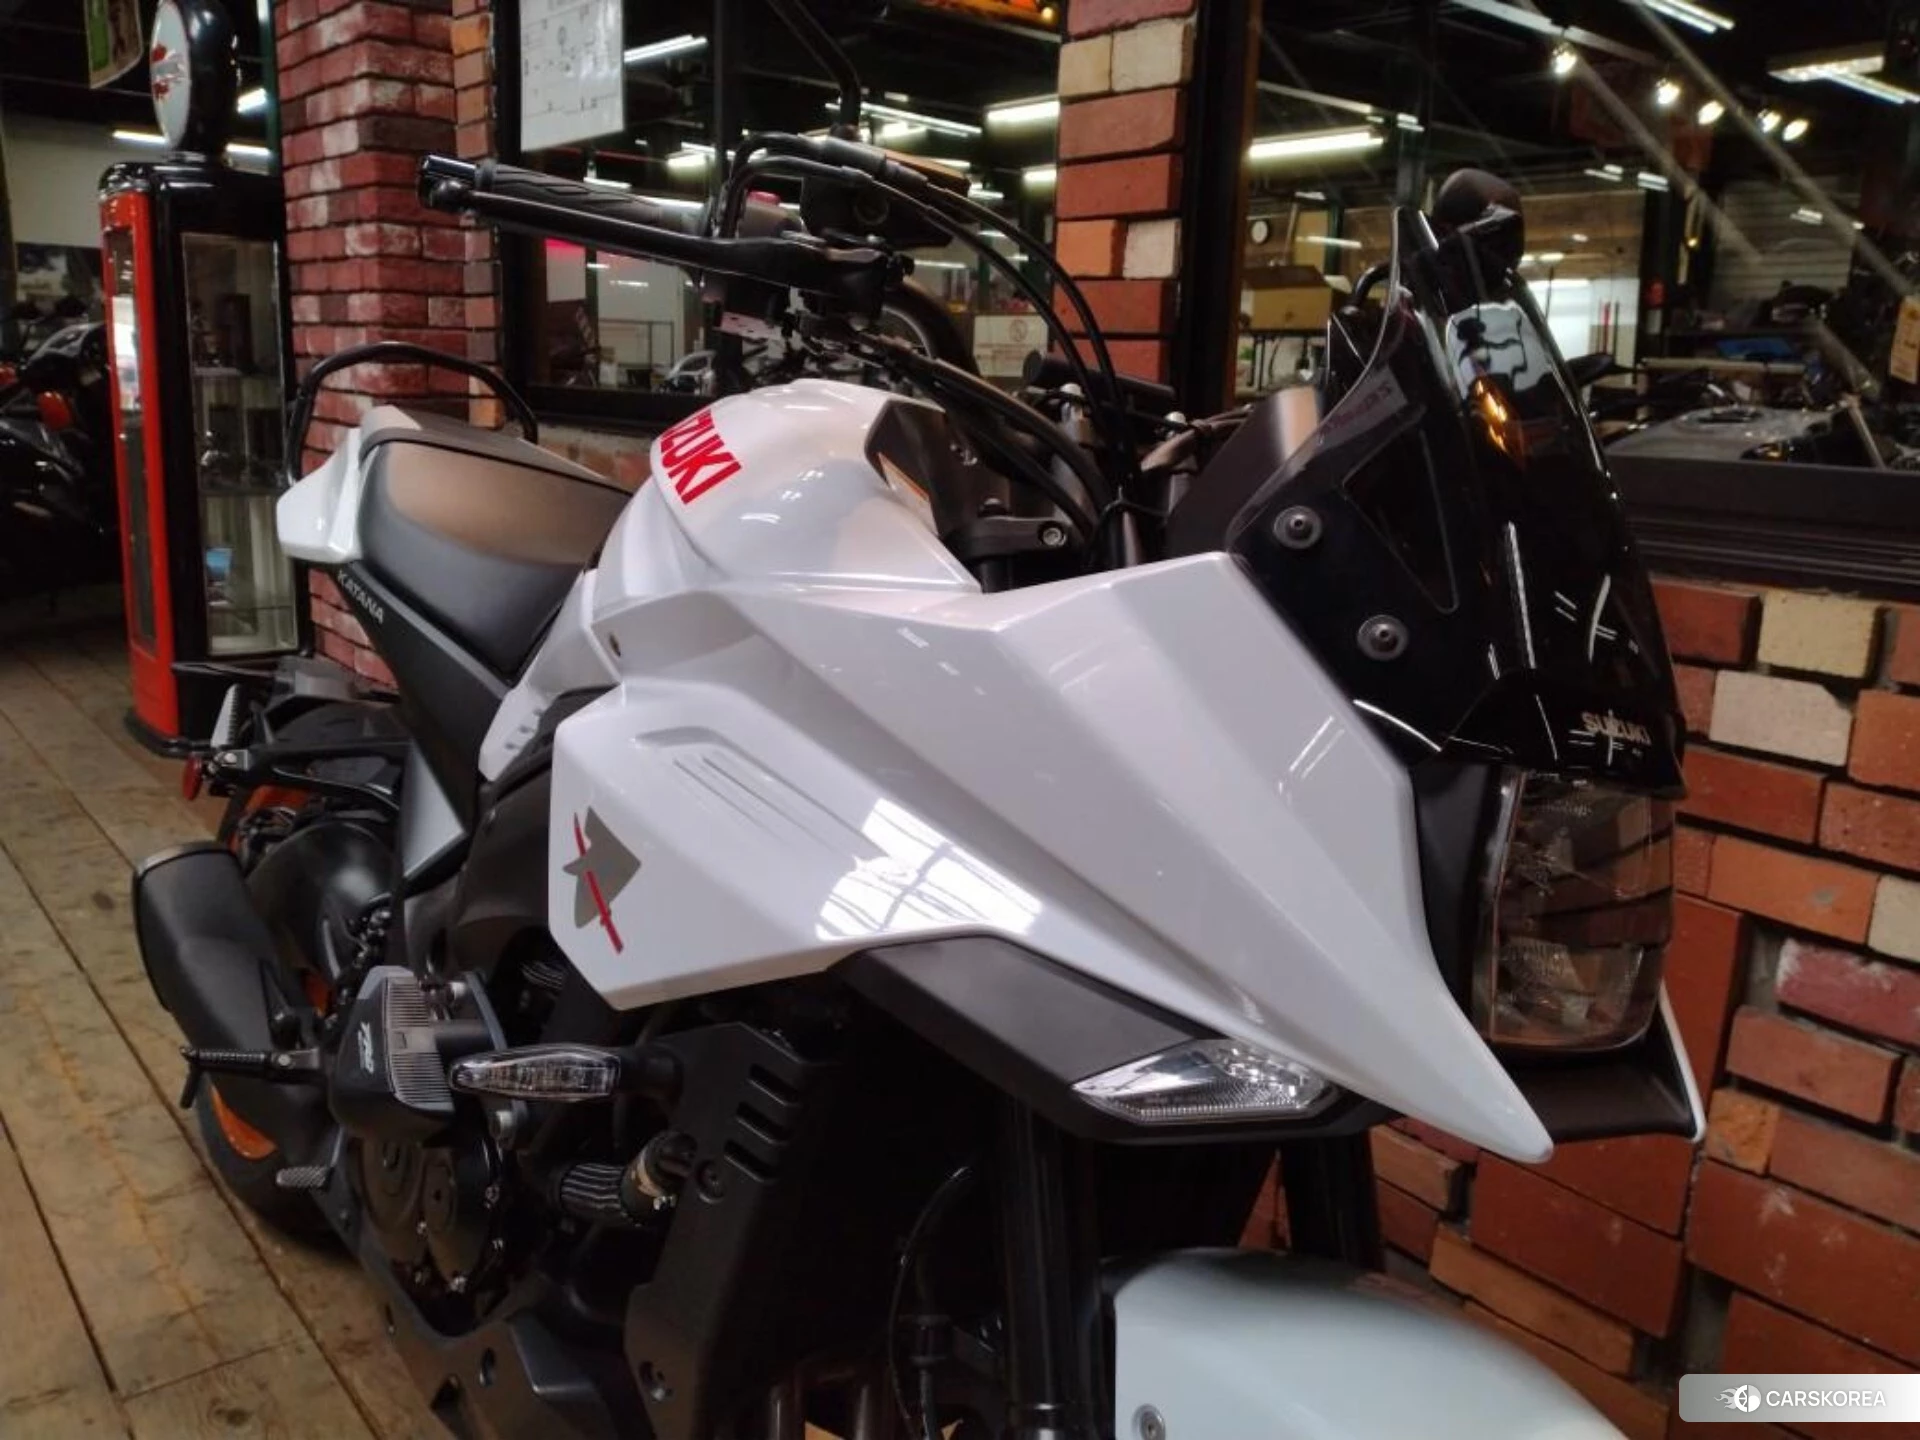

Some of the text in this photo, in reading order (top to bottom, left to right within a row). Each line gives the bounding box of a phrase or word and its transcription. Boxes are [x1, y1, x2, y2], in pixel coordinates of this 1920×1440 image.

[660, 409, 742, 505] ZUKI
[337, 569, 383, 624] KATANA
[1581, 711, 1652, 746] SUZUKI
